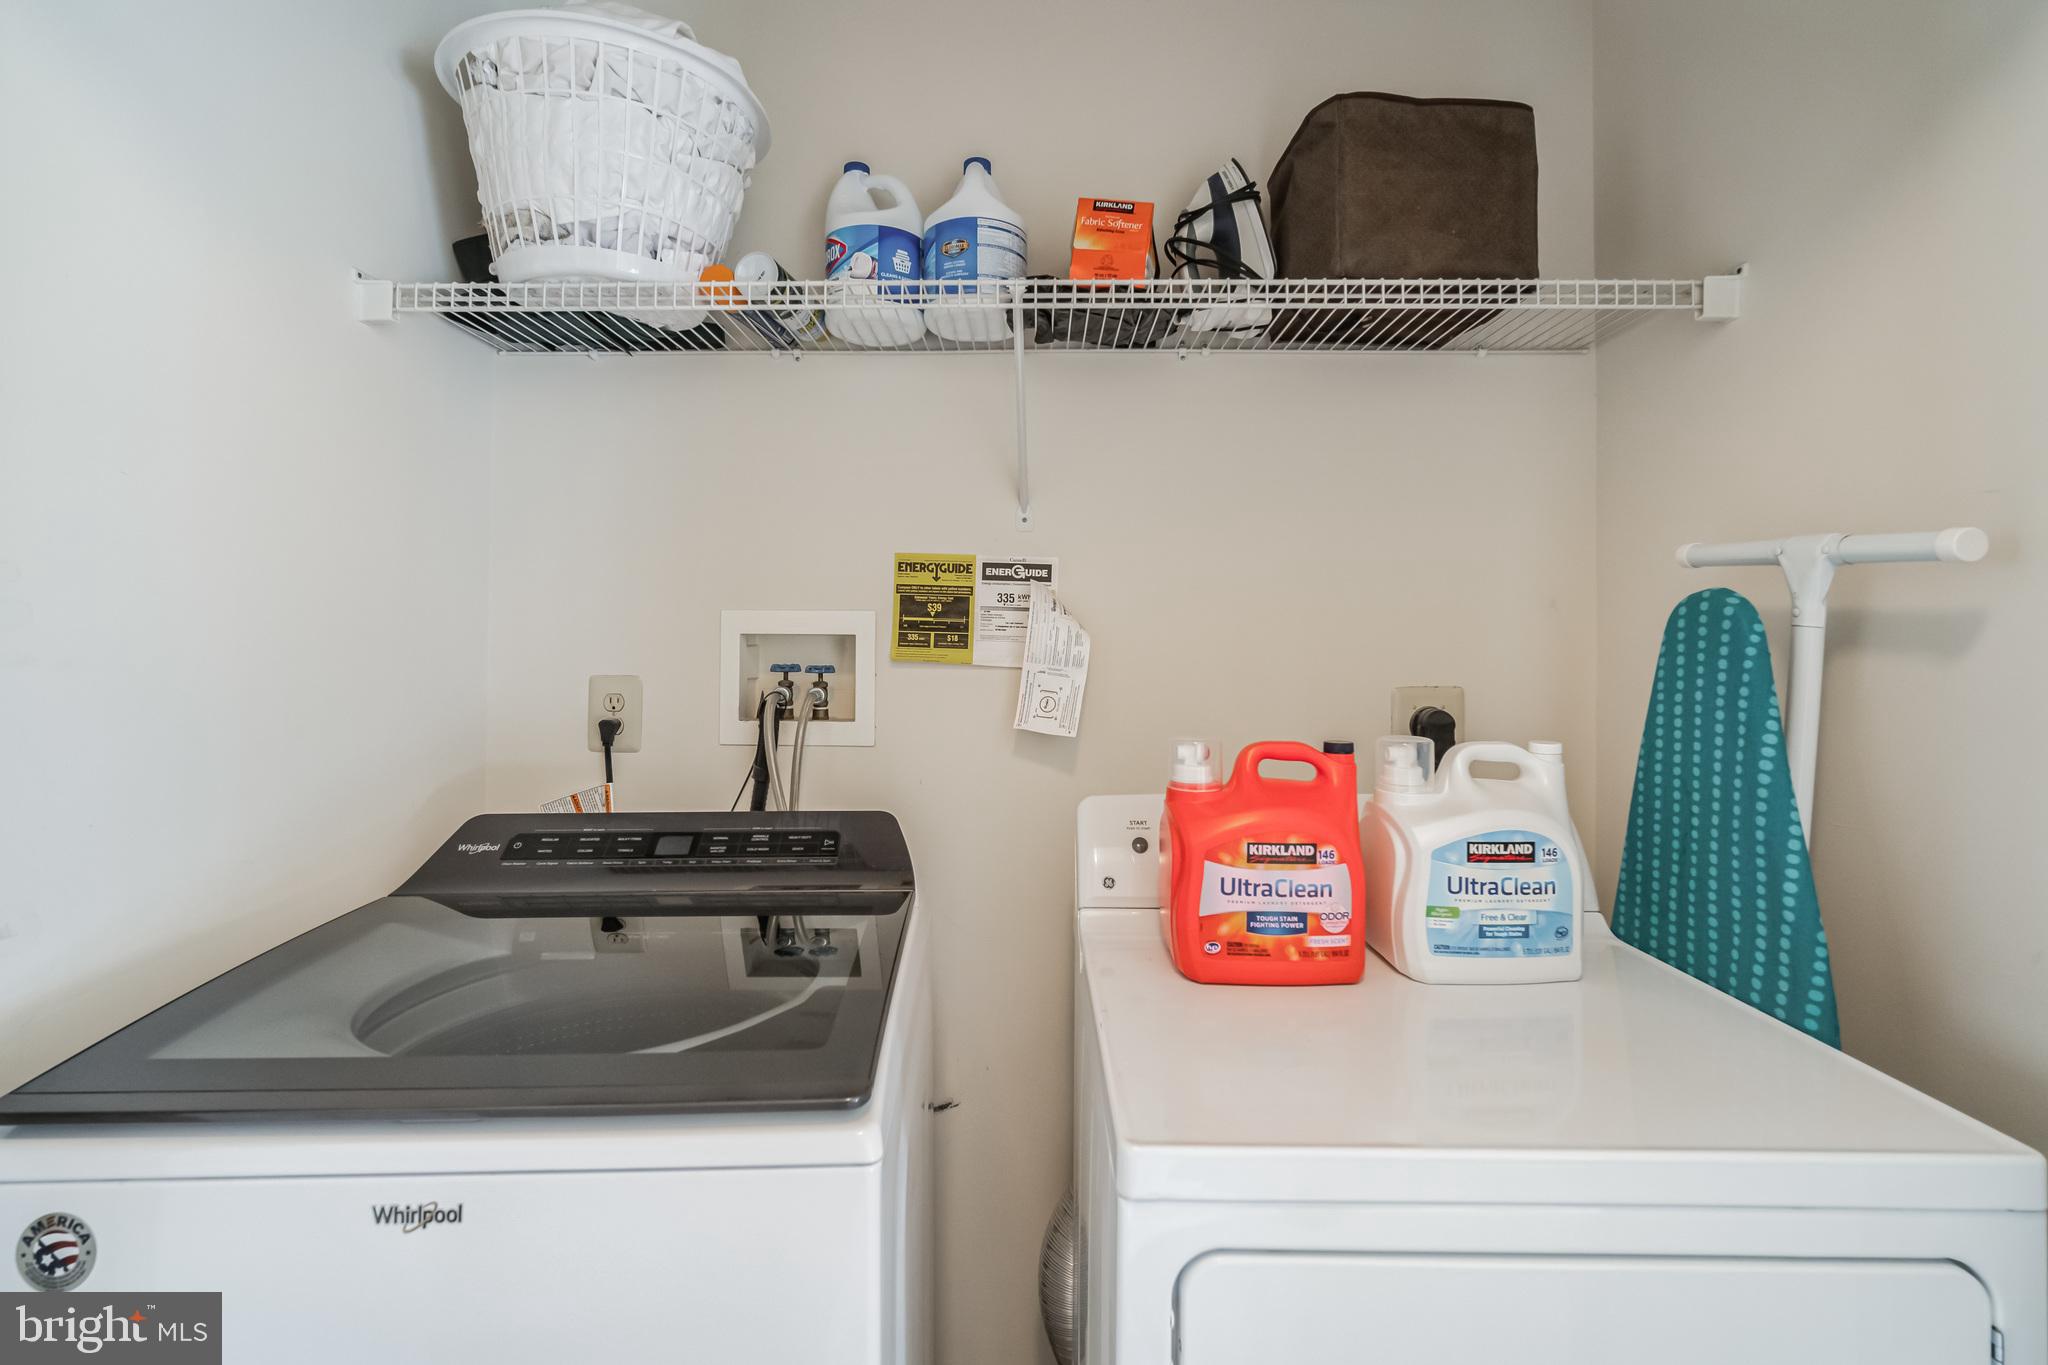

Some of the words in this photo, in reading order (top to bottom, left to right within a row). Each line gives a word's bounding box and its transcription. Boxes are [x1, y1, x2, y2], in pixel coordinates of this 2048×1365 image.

[1095, 201, 1133, 210] KIRKLAND
[1080, 216, 1105, 226] Fabric
[1107, 218, 1143, 230] Softener
[897, 561, 973, 577] ENERGYGUIDE
[985, 564, 1049, 579] ENERGUIDE
[997, 592, 1015, 603] 335
[927, 603, 942, 612] $39
[458, 842, 501, 854] Whirlpool
[1249, 844, 1315, 856] KIRKLAND
[1318, 849, 1335, 859] 146
[1469, 844, 1533, 854] KIRKLAND
[1541, 848, 1558, 857] 146
[1220, 877, 1333, 898] UltraClean
[1447, 876, 1556, 896] UltraClean
[1320, 911, 1350, 920] ODOR
[1480, 913, 1499, 921] Free
[1507, 913, 1528, 921] Clear
[372, 1202, 462, 1231] Whirlpool
[22, 1215, 91, 1248] AMERICA
